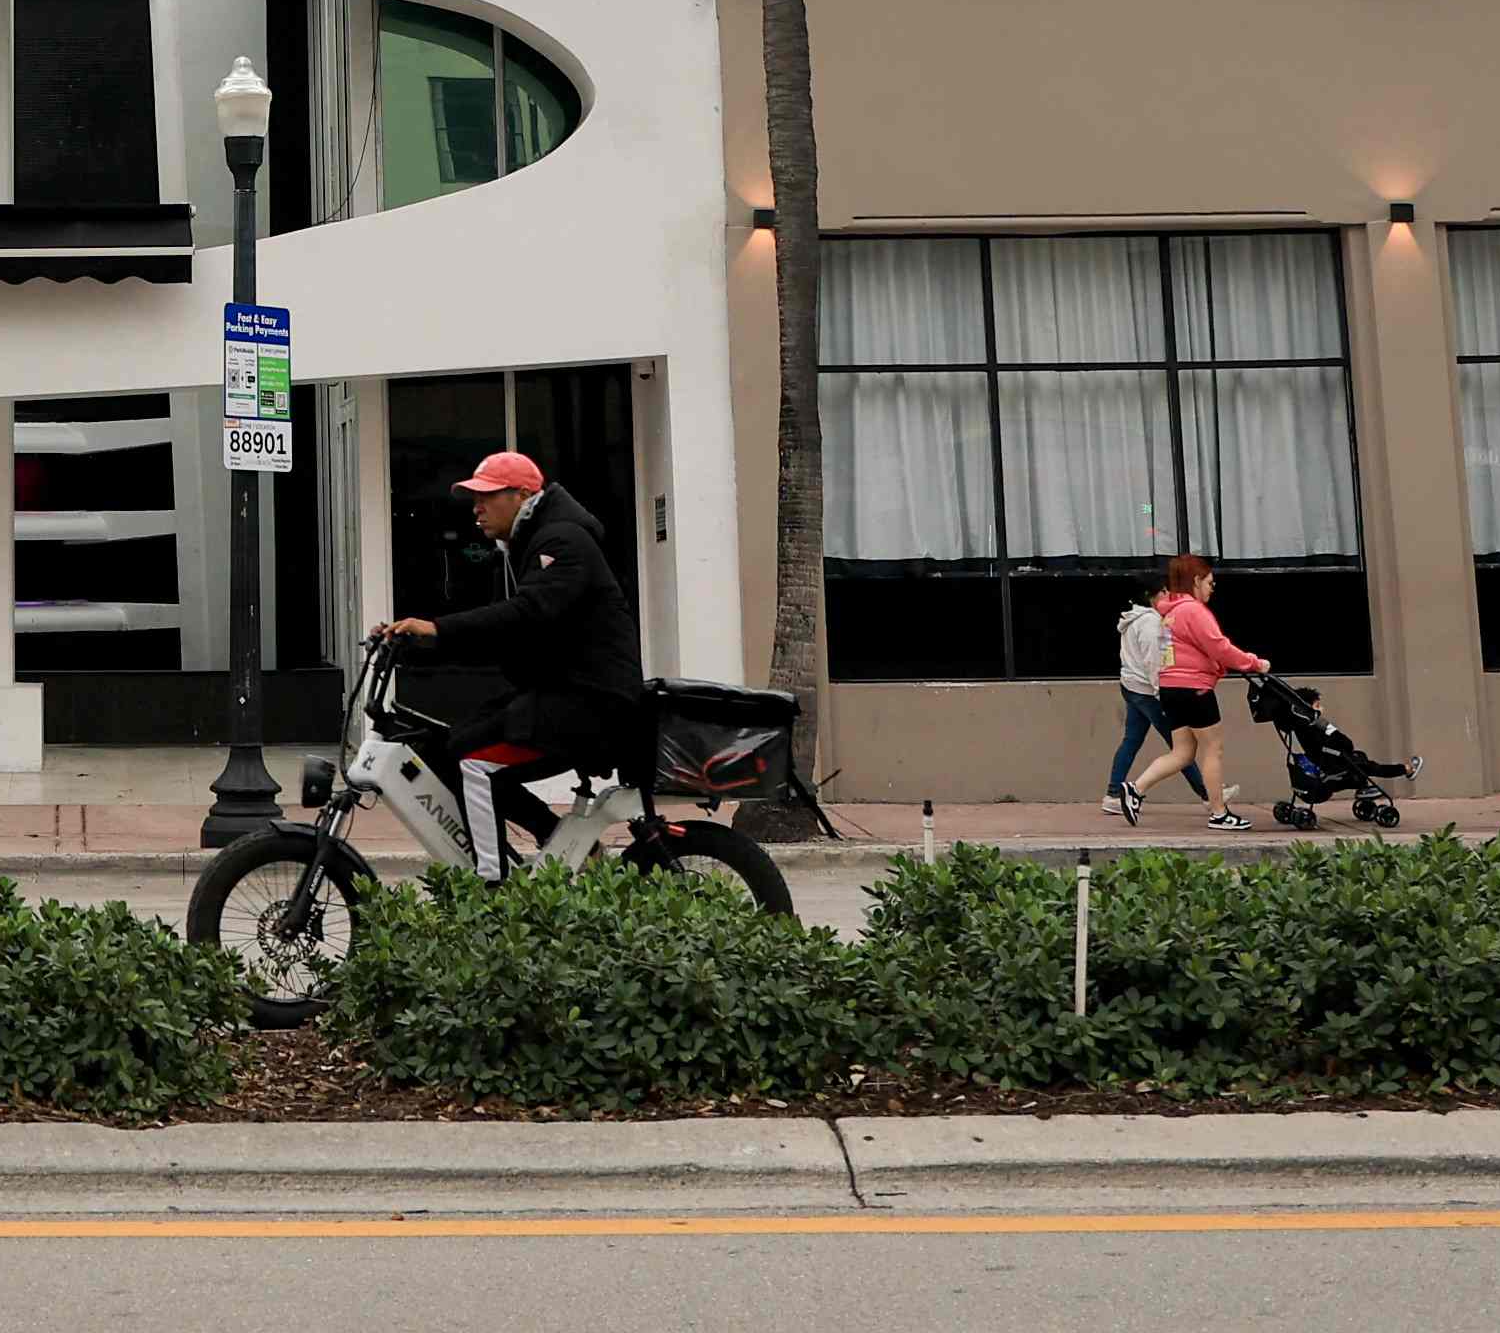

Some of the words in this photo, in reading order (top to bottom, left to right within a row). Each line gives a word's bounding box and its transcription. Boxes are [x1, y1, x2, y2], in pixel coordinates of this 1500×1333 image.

[237, 312, 252, 323] Fast
[253, 313, 260, 324] &
[260, 314, 278, 328] Easy
[225, 321, 254, 336] Parking
[255, 324, 289, 337] Payments
[230, 430, 287, 455] 88901
